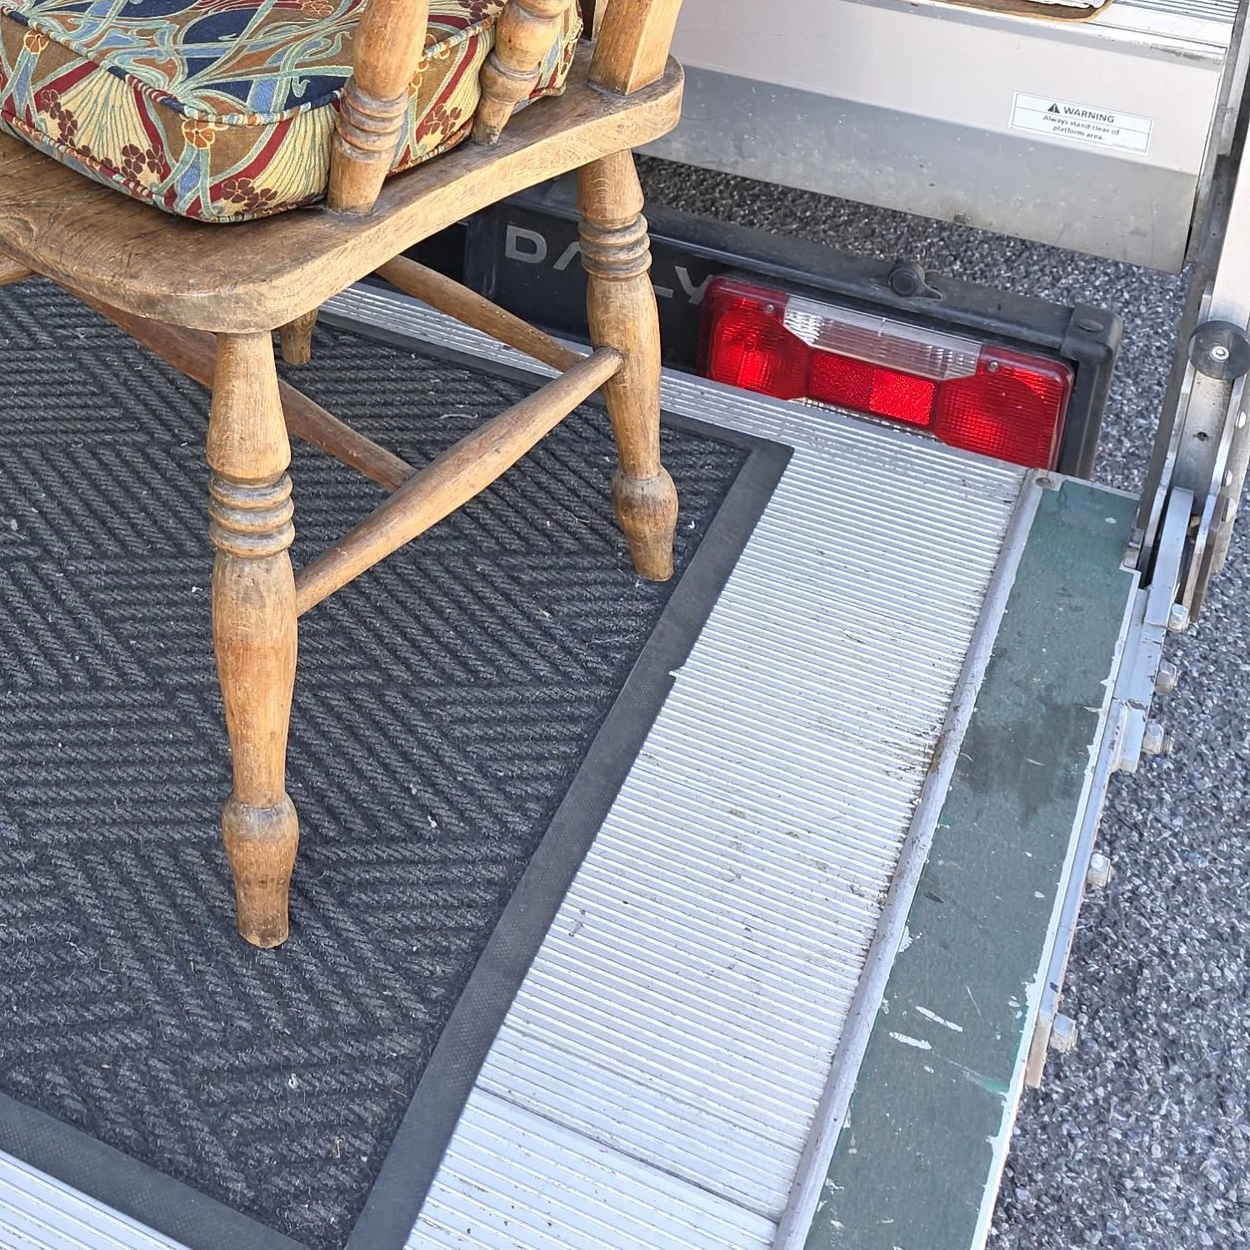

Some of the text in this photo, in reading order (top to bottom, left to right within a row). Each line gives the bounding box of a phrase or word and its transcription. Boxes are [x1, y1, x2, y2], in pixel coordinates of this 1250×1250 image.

[1064, 107, 1115, 123] WARNING
[1043, 115, 1069, 125] Always
[1070, 119, 1091, 129] stand
[1092, 123, 1110, 133] clear
[1053, 125, 1085, 137] platform
